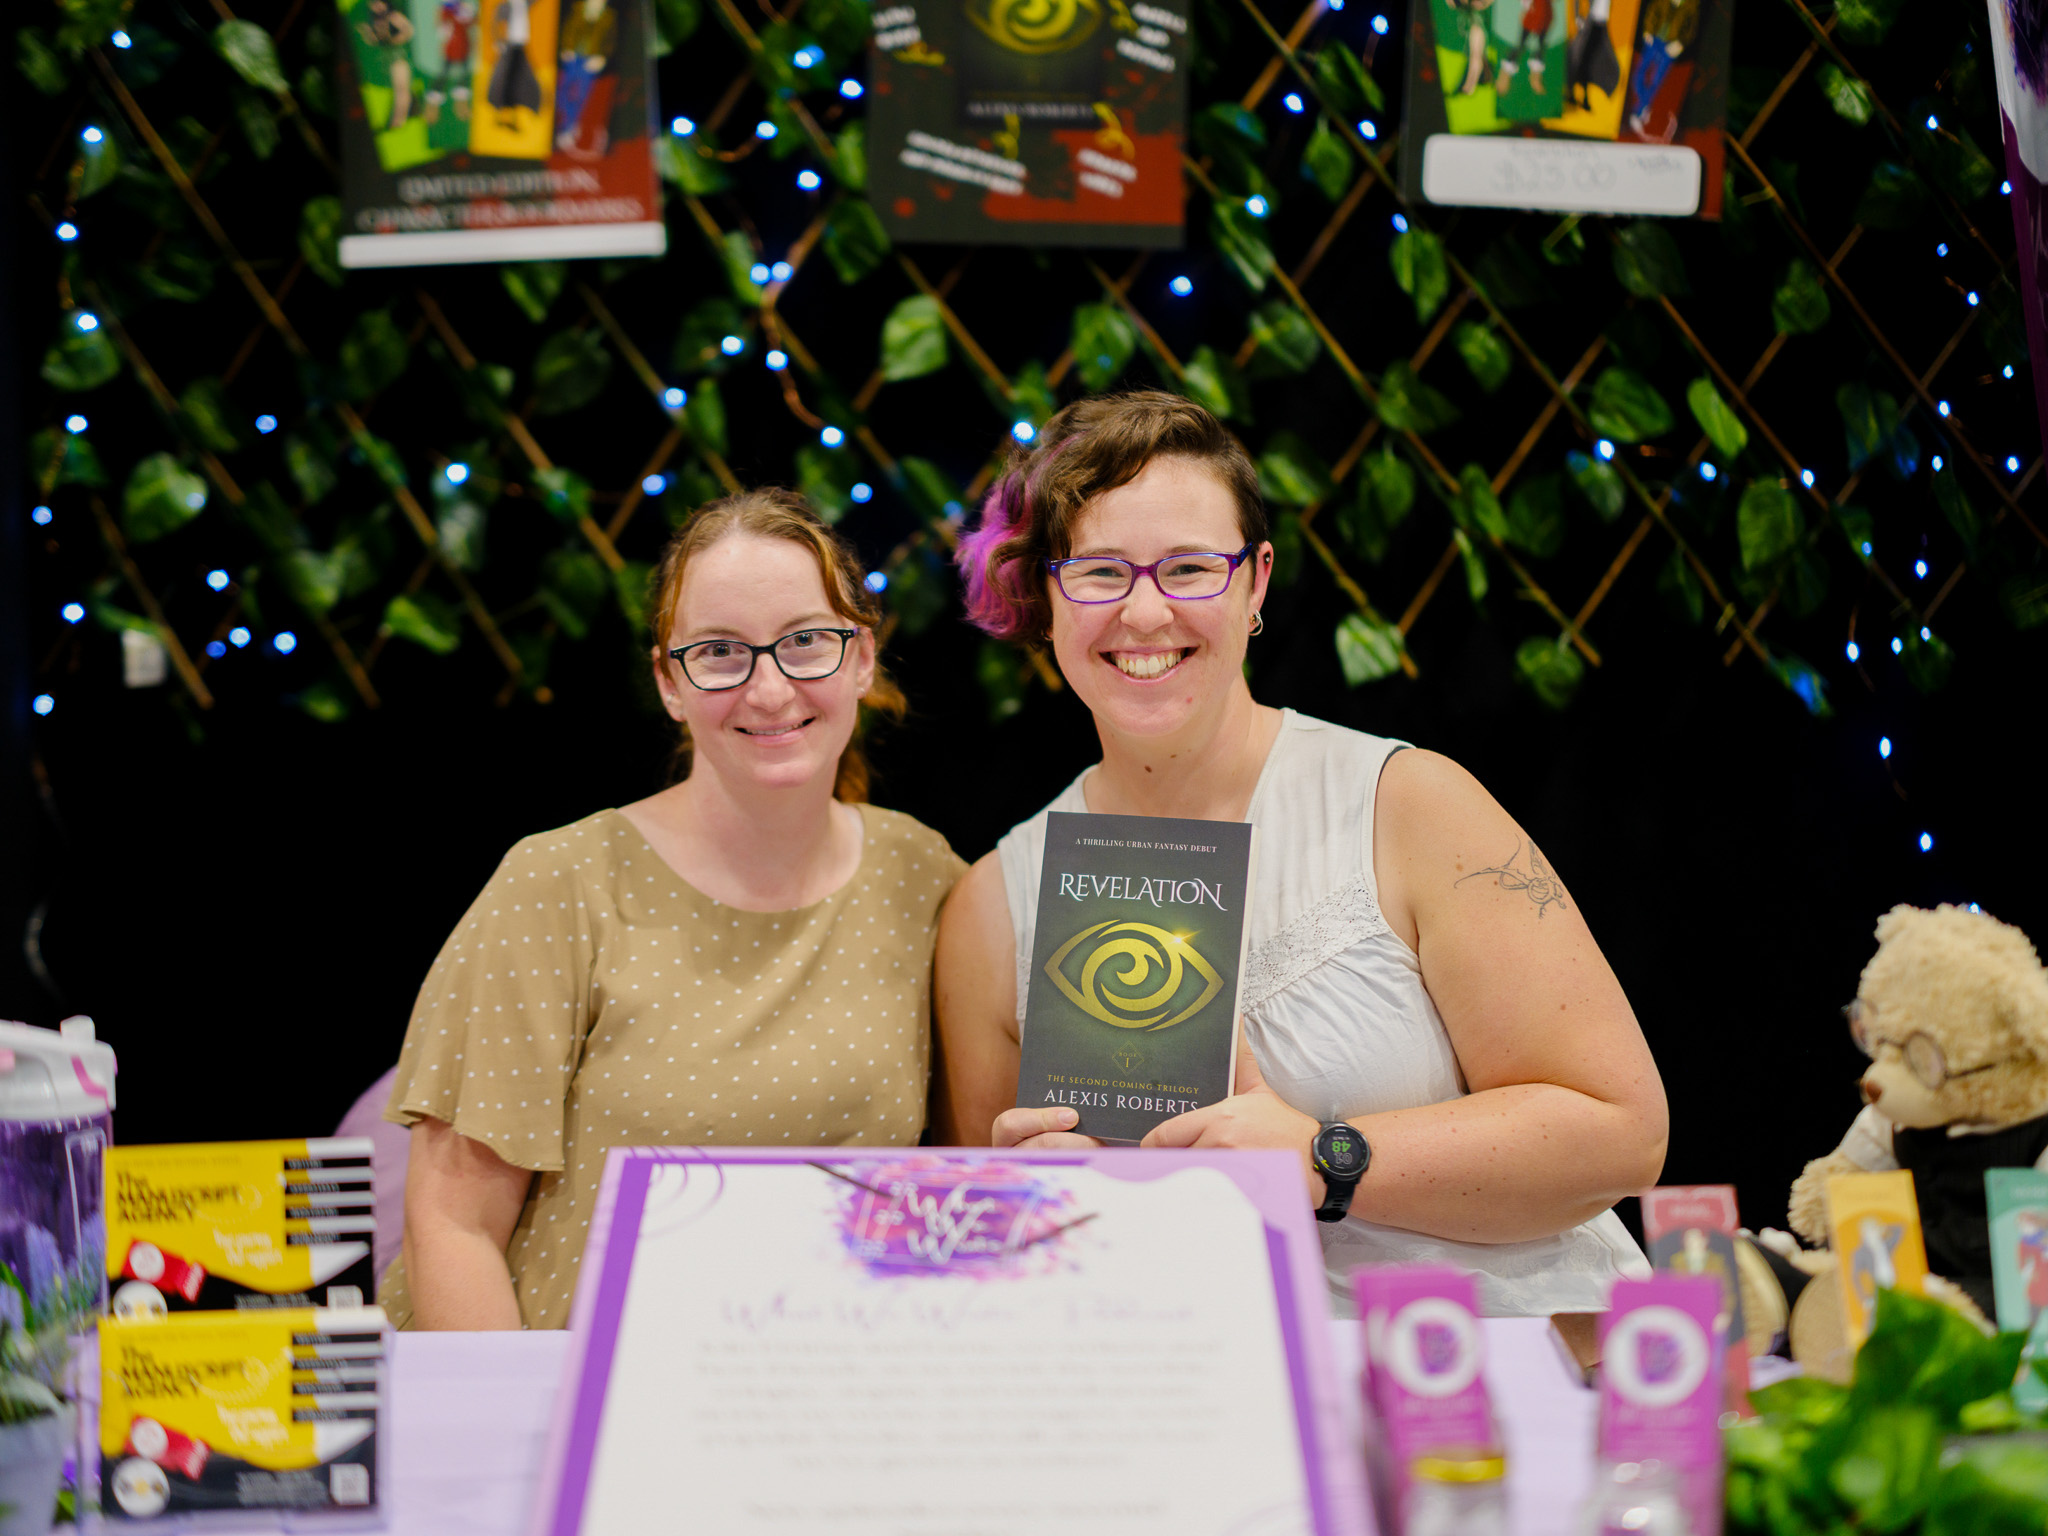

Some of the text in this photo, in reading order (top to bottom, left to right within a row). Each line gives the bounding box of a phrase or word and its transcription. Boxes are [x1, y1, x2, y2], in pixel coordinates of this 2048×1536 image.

[1083, 838, 1124, 847] THRILLING
[1126, 840, 1152, 849] URBAN
[1154, 842, 1189, 851] FANTASY
[1190, 845, 1217, 853] DEBUT
[1059, 873, 1228, 911] REVELATION
[1048, 1074, 1199, 1095] THE SECOND COMING TRILOGY
[1043, 1089, 1198, 1114] ALEXIS ROBERTS
